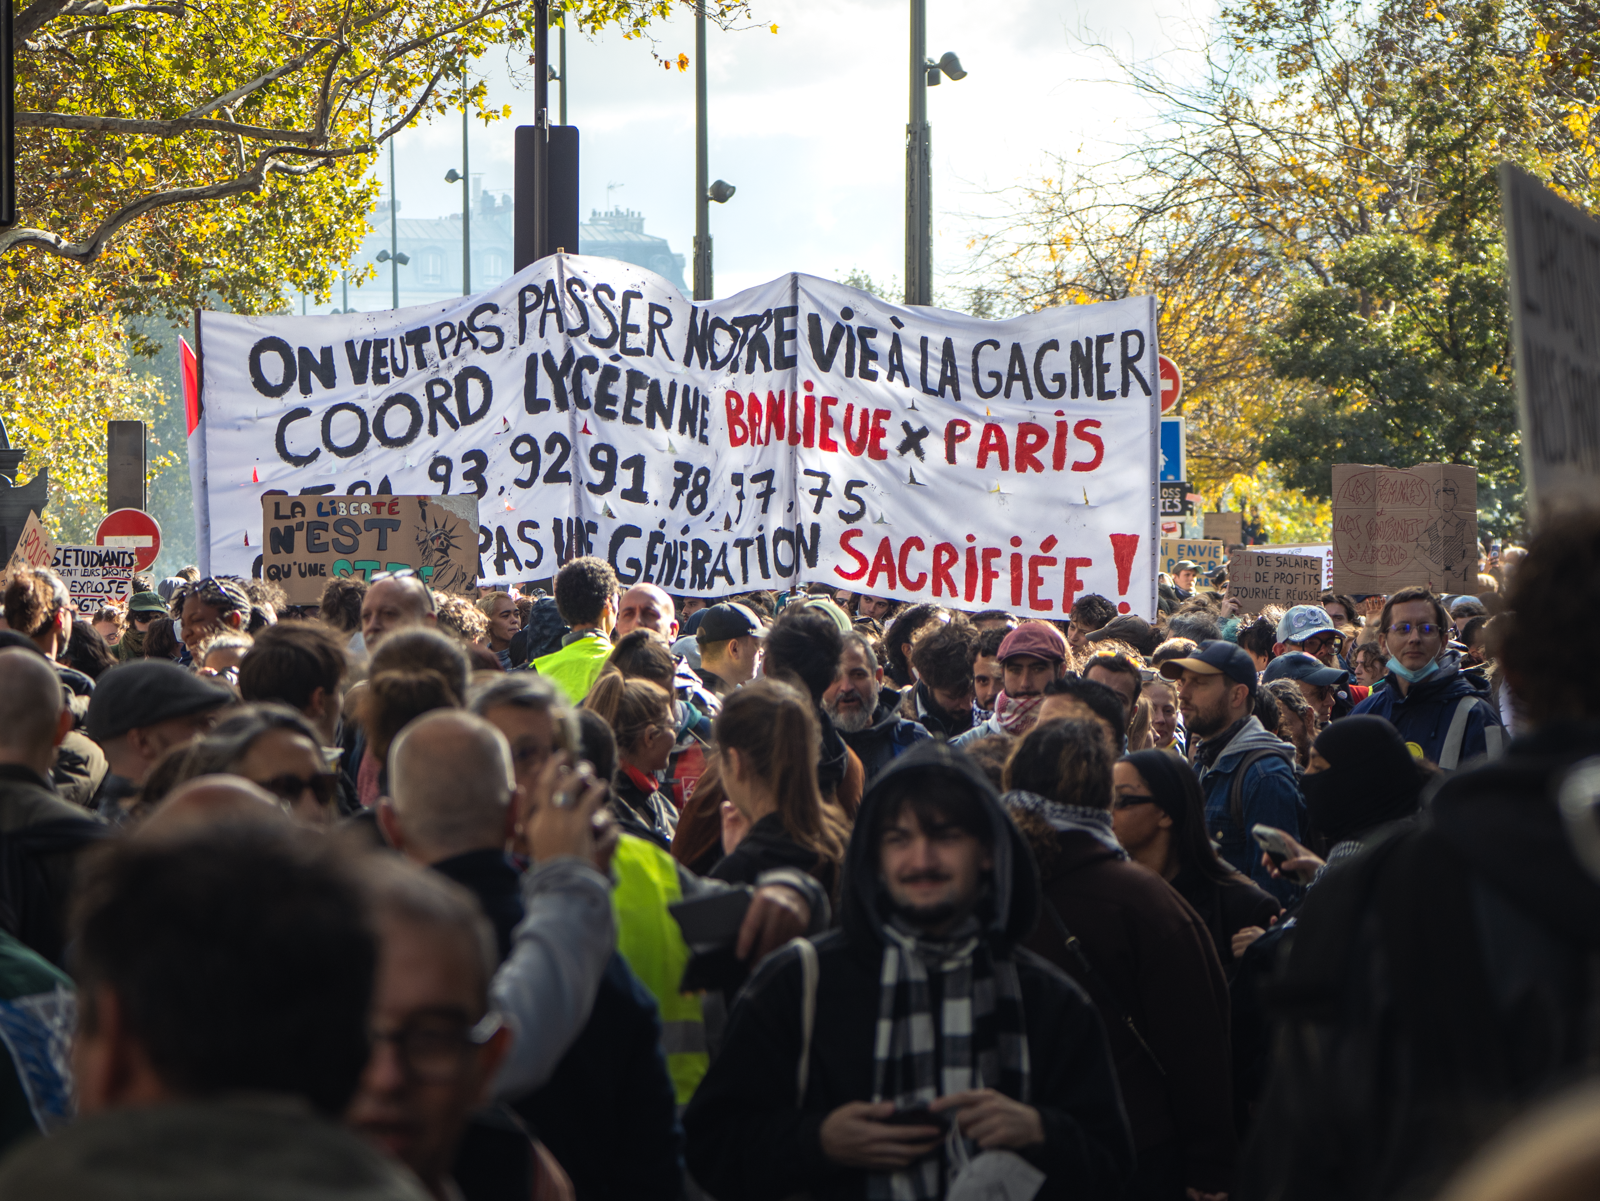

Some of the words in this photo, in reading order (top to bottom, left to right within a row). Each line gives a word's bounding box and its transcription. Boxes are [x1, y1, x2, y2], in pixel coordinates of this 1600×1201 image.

[249, 336, 337, 398] ON
[345, 326, 431, 386] VEUT
[435, 302, 504, 360] PAS
[518, 277, 675, 361] PASSER
[683, 305, 799, 375] NOTRE
[887, 316, 910, 388] À
[920, 336, 961, 401] LA
[971, 329, 1152, 401] GAGNER
[275, 365, 493, 468] COORD
[524, 346, 709, 446] LYCÉENNE
[804, 469, 869, 524] 75
[274, 501, 306, 520] LA
[270, 518, 401, 555] N'EST
[267, 561, 326, 582] QU'UNE
[1257, 556, 1271, 567] DE
[70, 580, 128, 594] EXPLOSE
[1255, 572, 1269, 583] DE
[1233, 585, 1281, 600] JOURNÉE
